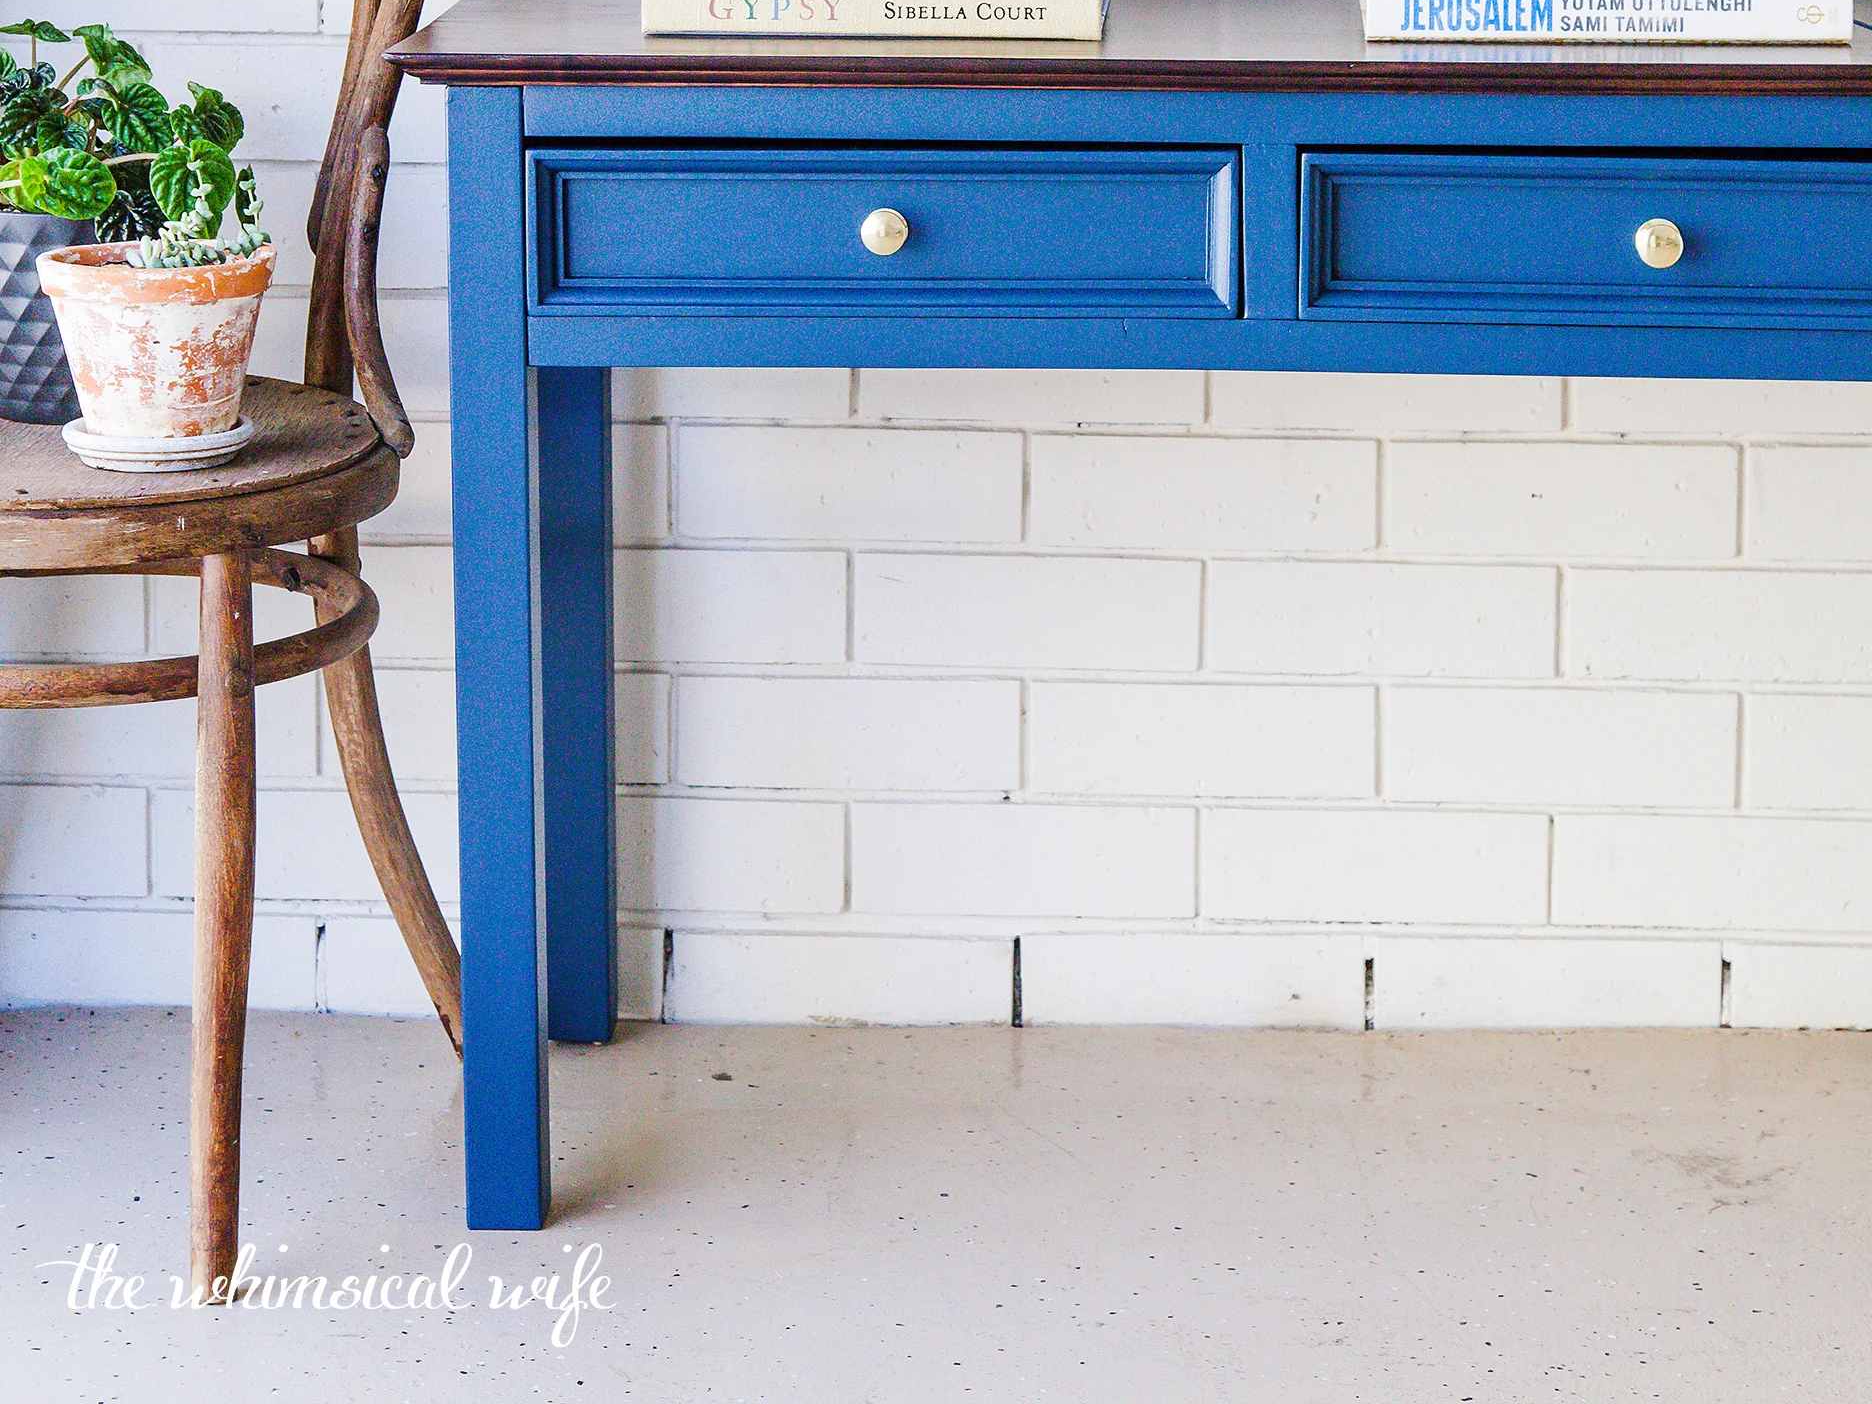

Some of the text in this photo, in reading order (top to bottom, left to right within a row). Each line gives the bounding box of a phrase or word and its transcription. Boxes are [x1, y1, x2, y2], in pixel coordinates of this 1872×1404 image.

[884, 1, 1048, 21] SIBELLA COURT
[1560, 15, 1685, 33] SAMI TAMIMI
